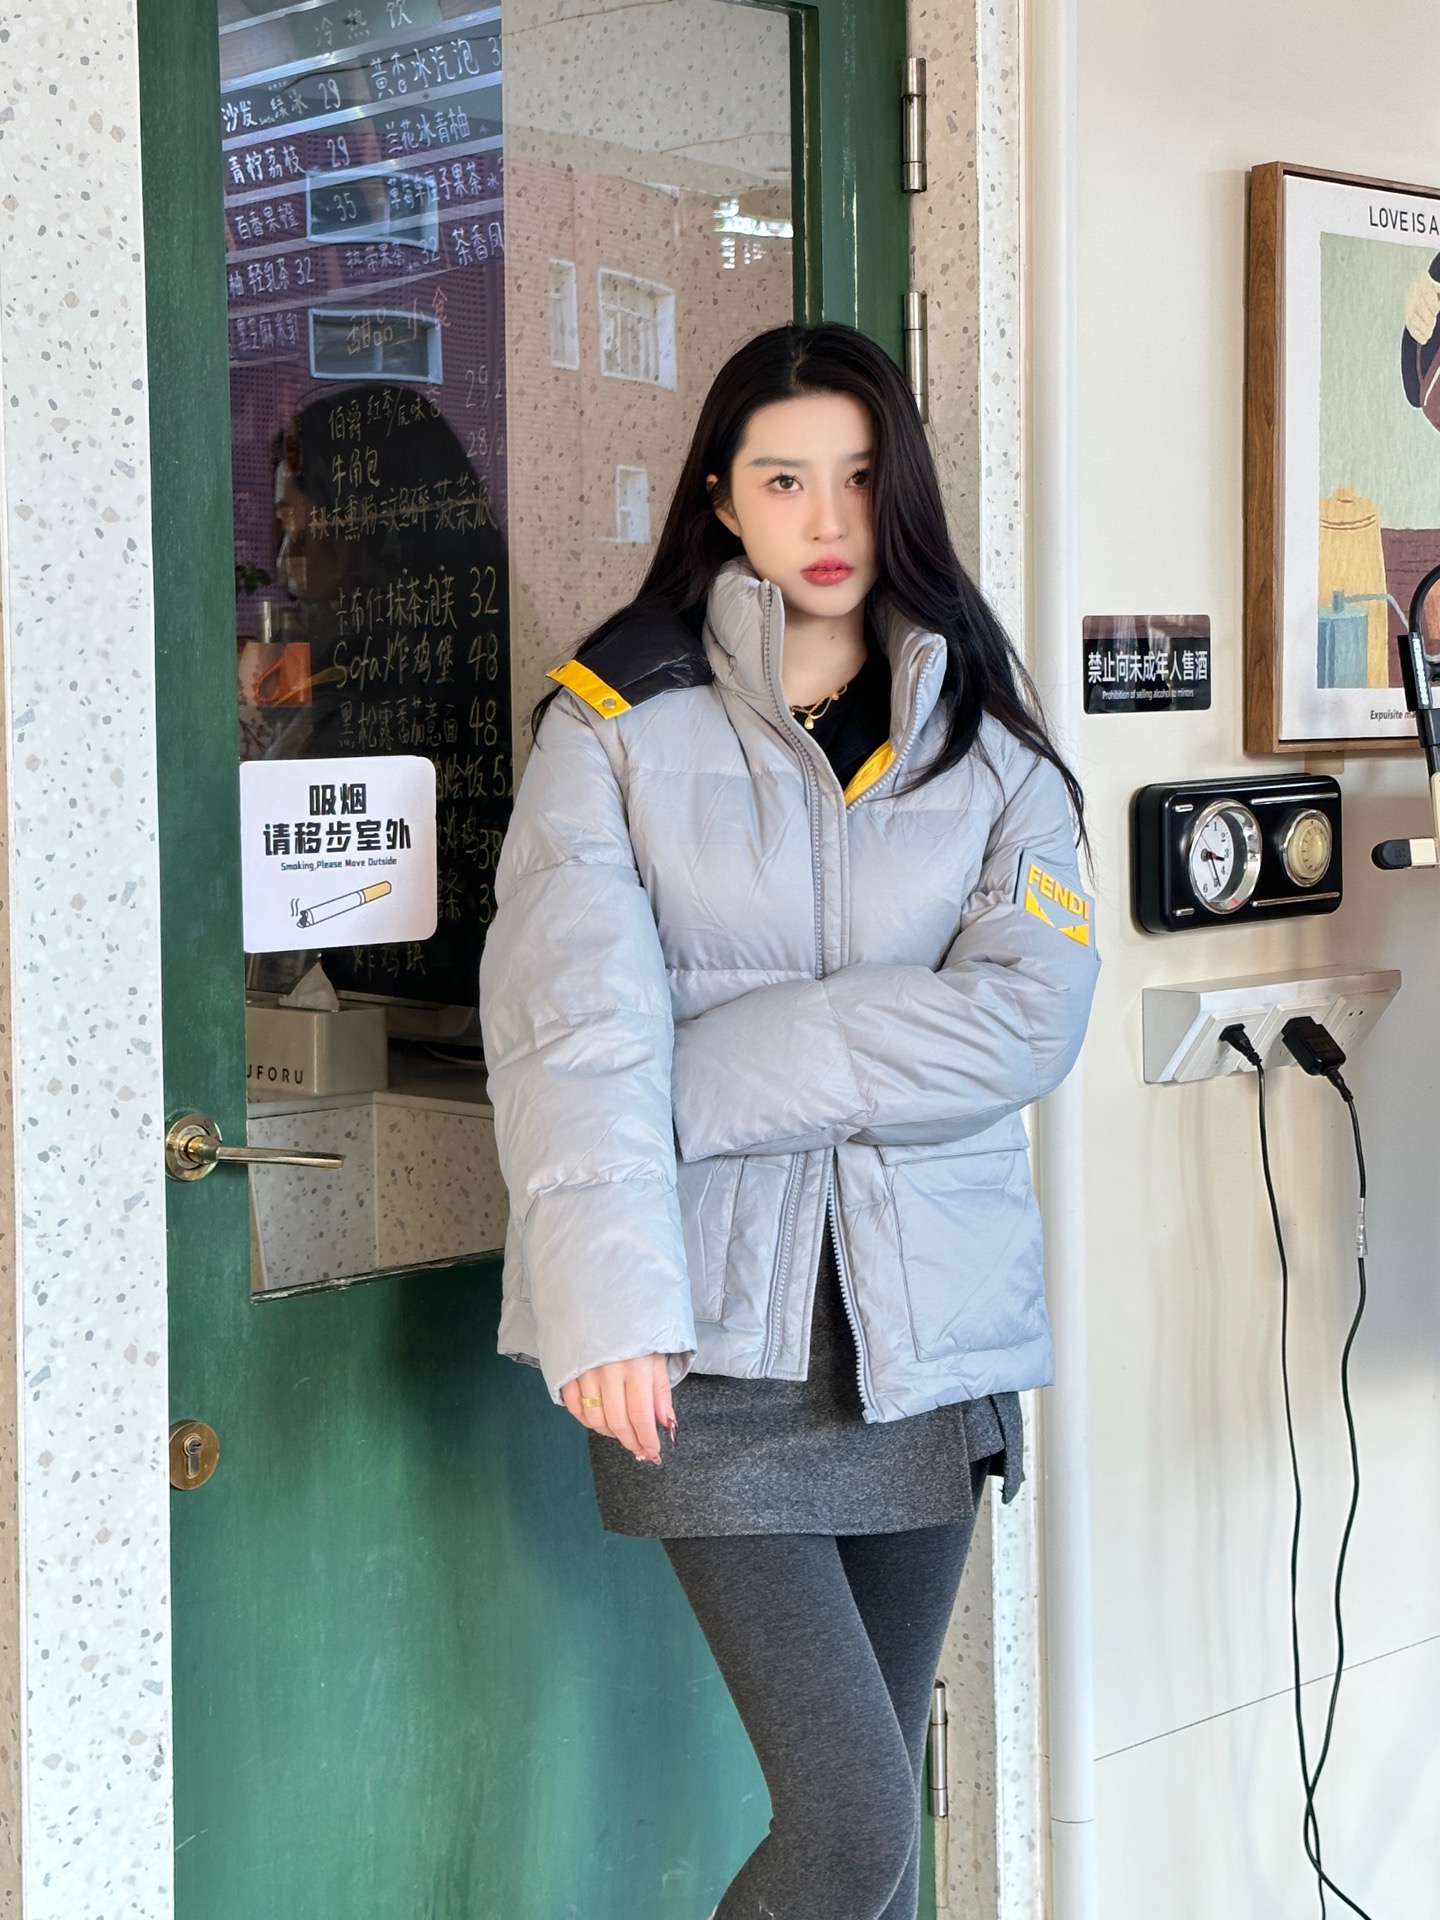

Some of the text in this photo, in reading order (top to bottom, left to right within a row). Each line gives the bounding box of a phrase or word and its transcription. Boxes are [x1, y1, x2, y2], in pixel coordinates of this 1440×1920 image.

[221, 99, 258, 132] 沙发
[318, 78, 342, 111] 29
[227, 135, 350, 185] 青柠荔枝 29
[333, 192, 358, 223] 35
[1369, 205, 1409, 232] LOVE
[1412, 211, 1426, 234] IS
[295, 256, 316, 286] 32
[469, 566, 499, 618] 32
[467, 633, 499, 681] 48
[1088, 650, 1208, 684] 禁止向未成年人售酒
[469, 697, 498, 746] 48
[309, 783, 367, 816] 吸烟
[263, 818, 412, 856] 请移步室外
[345, 859, 366, 867] Move
[368, 857, 397, 866] Outside
[1027, 863, 1090, 922] FENDI
